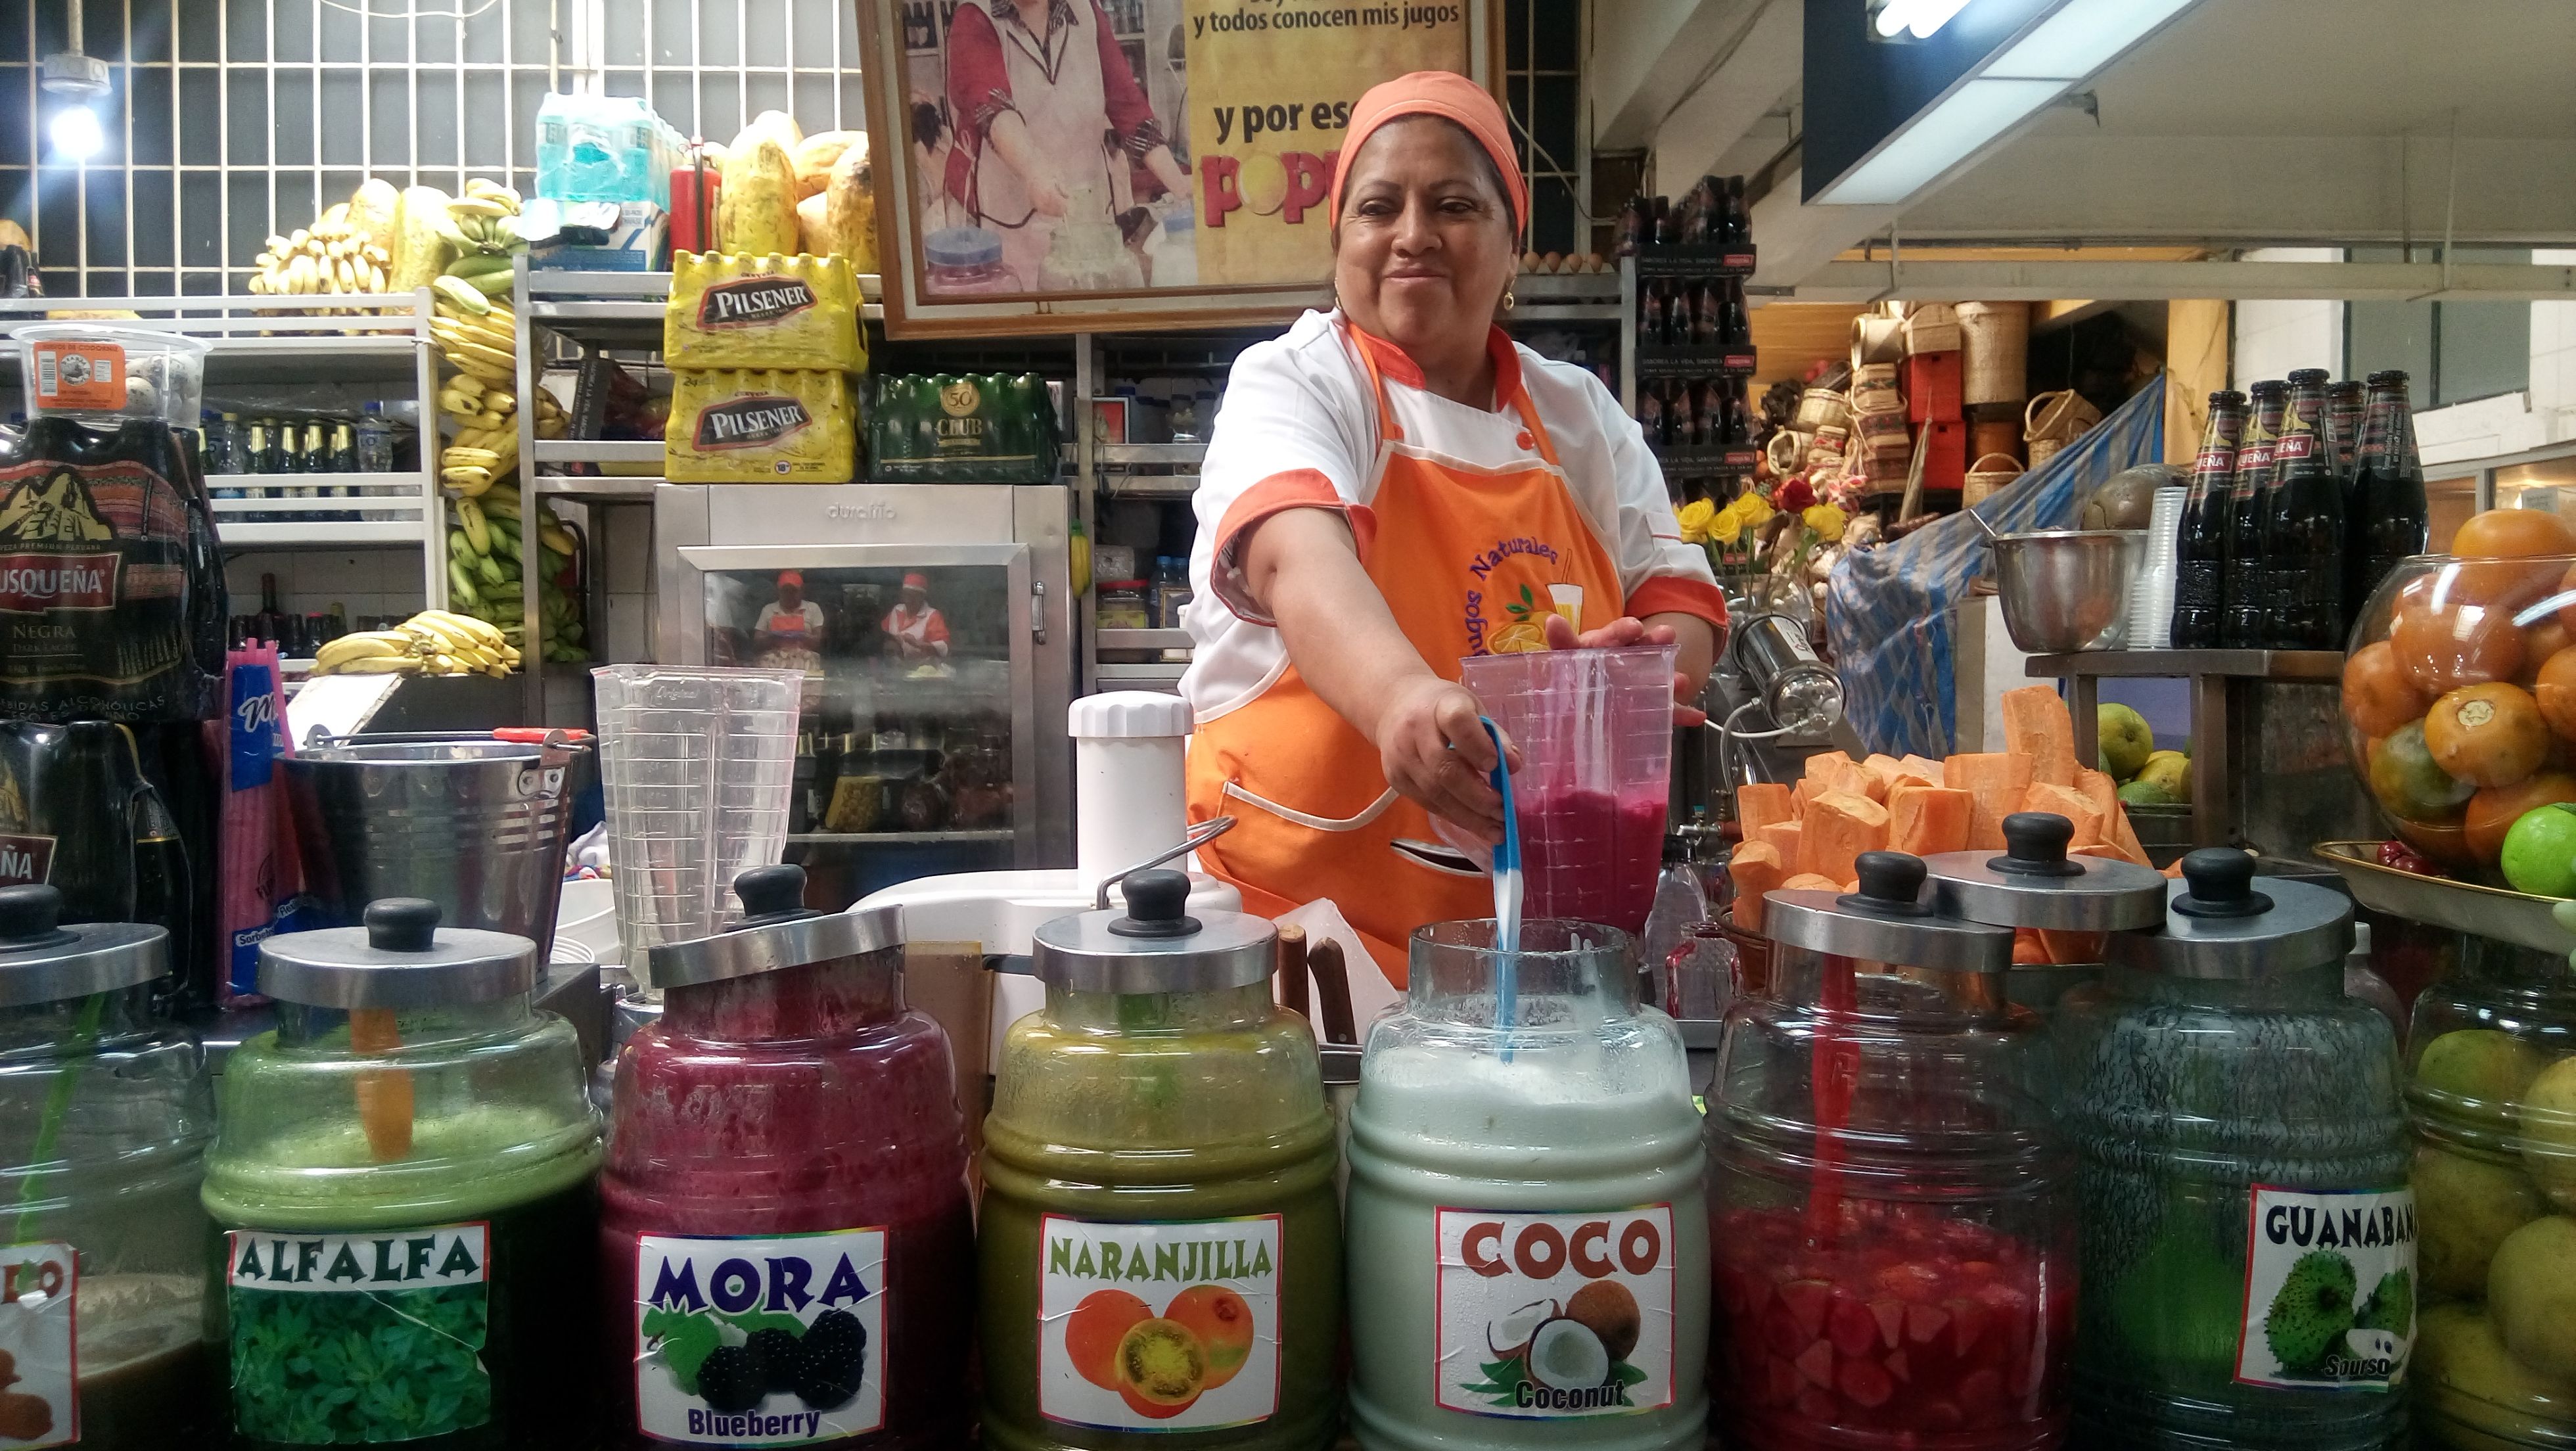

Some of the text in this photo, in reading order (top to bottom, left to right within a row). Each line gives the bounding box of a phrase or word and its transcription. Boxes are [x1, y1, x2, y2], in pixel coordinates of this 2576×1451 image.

[1193, 1, 1460, 39] y todos conocen mis jugos
[1213, 101, 1358, 145] y por es
[715, 285, 809, 318] PILSENER
[950, 391, 973, 406] 50
[710, 404, 804, 440] PILSENER
[937, 418, 983, 436] CLUB
[1469, 536, 1558, 582] Naturales
[12, 625, 78, 639] NEGRA
[2265, 1203, 2418, 1249] GUANABAN
[237, 1235, 480, 1285] ALFALFA
[1049, 1235, 1273, 1283] NARANJILLA
[1461, 1219, 1661, 1279] COCO
[647, 1252, 871, 1314] MORA
[1515, 1380, 1626, 1410] Coconut
[687, 1408, 821, 1438] Blueberry
